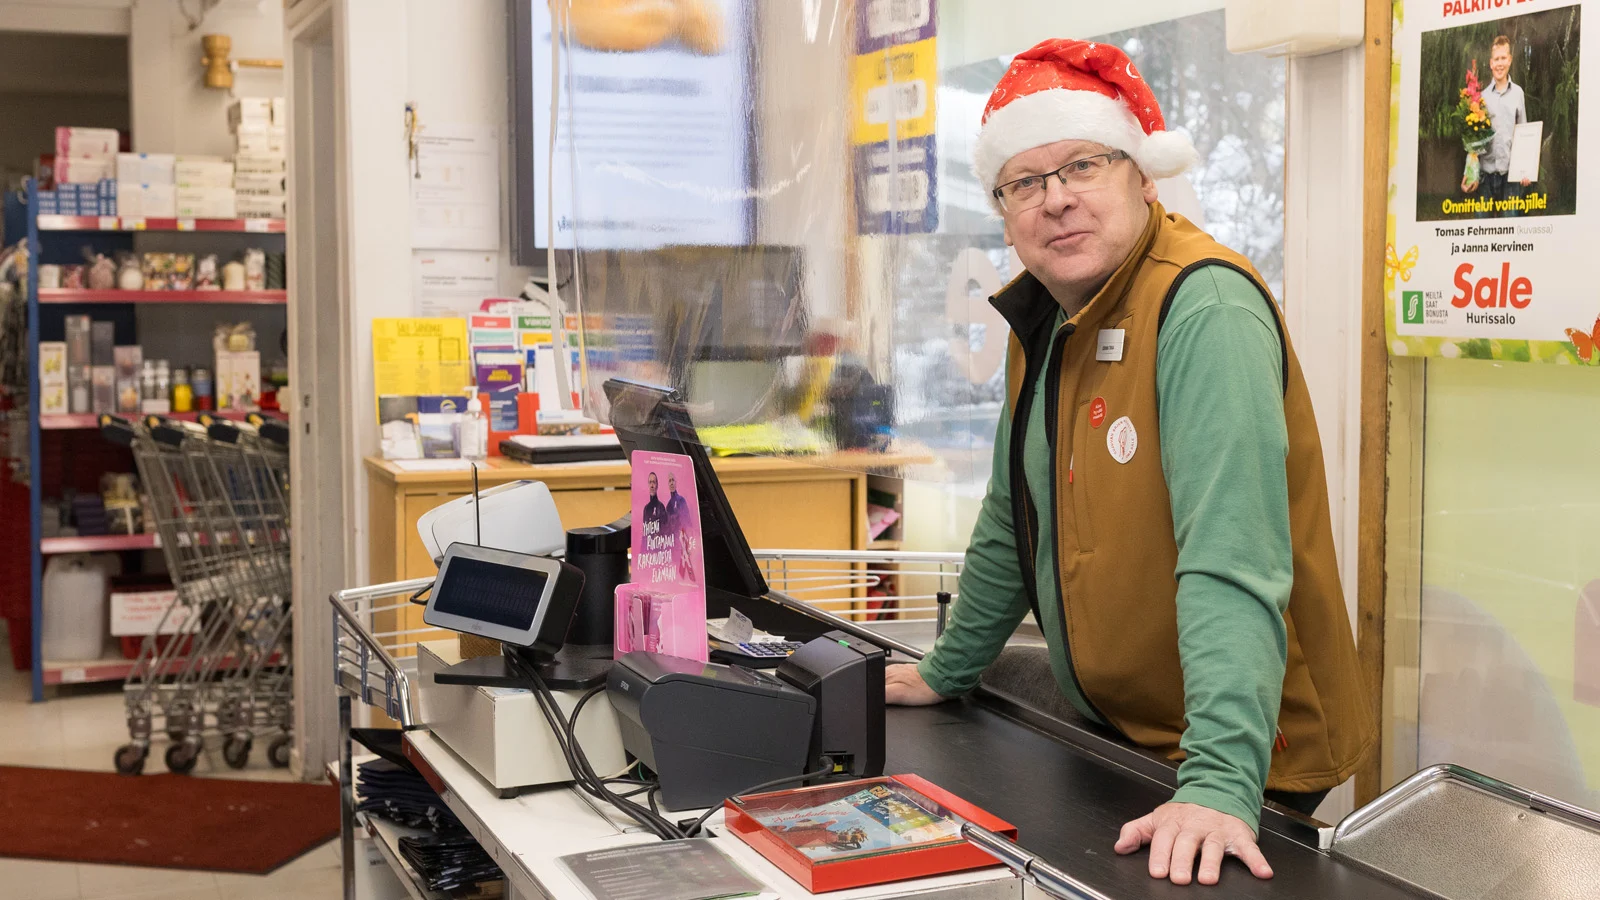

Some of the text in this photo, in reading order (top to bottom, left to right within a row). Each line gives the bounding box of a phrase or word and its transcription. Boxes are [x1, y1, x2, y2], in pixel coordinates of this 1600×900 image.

[1442, 192, 1547, 214] Onnittelut voittajille!
[1435, 224, 1554, 237] Tomas Fehrmann (kuvassa)
[1451, 241, 1534, 256] ja Janna Kervinen
[1451, 262, 1533, 309] Sale
[1425, 291, 1443, 300] MEILTÄ
[1425, 300, 1438, 308] SAAT
[1425, 309, 1449, 318] BONUSTA
[1466, 312, 1516, 325] Hurissalo
